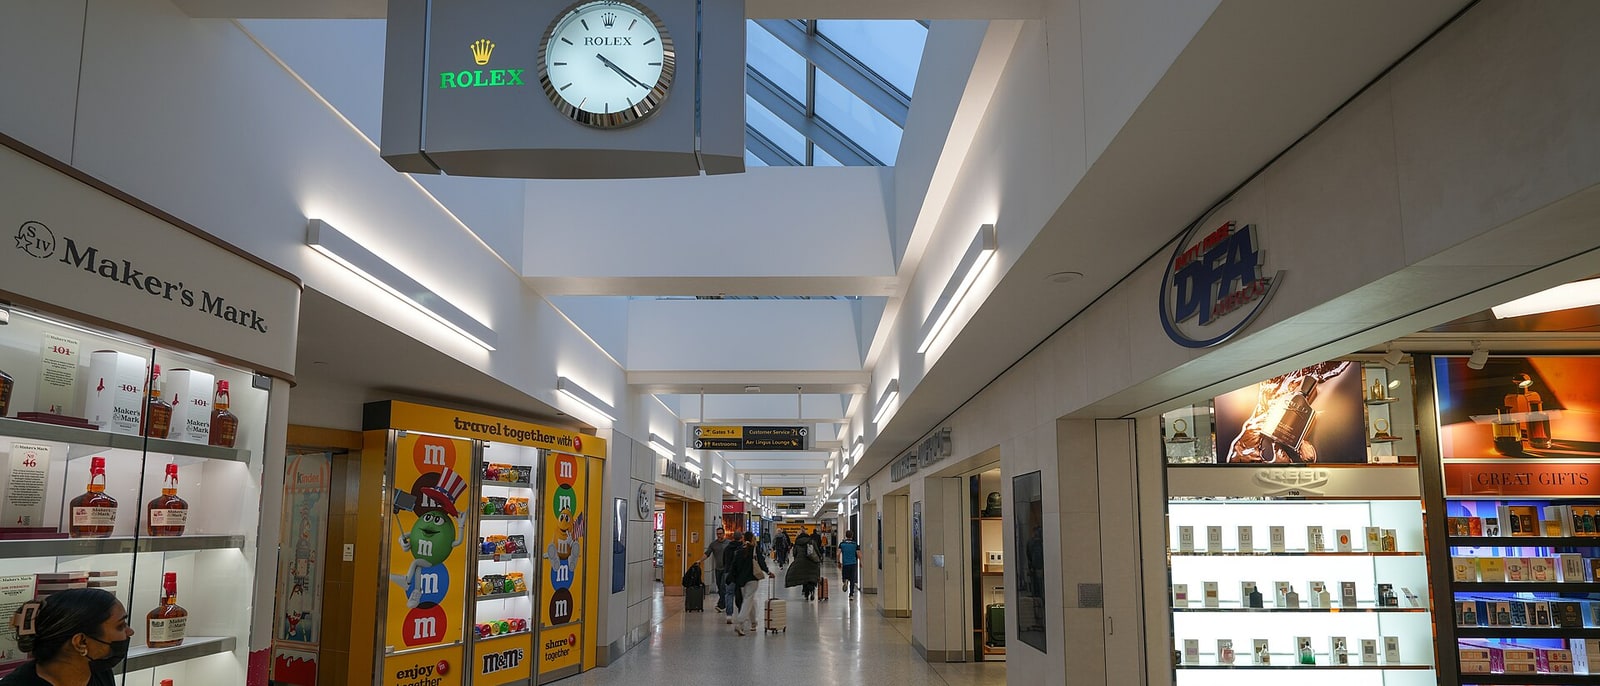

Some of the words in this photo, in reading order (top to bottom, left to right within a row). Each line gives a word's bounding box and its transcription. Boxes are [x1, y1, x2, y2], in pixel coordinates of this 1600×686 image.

[584, 36, 633, 46] ROLEX
[439, 69, 525, 89] ROLEX
[27, 226, 36, 238] S
[1173, 224, 1262, 326] DFA
[59, 237, 194, 307] Maker's
[199, 290, 267, 334] Mark
[52, 345, 71, 356] 101
[121, 384, 138, 393] 101
[194, 398, 207, 407] 101
[113, 406, 141, 417] Maker's
[120, 414, 140, 424] Mark
[186, 418, 210, 428] Maker's
[192, 425, 209, 434] Mark
[453, 416, 502, 436] travel
[503, 425, 556, 445] together
[557, 433, 573, 447] with
[22, 459, 37, 468] 46
[1255, 469, 1329, 482] CREED
[1477, 472, 1534, 486] GREAT
[1538, 472, 1590, 486] GIFTS
[545, 636, 568, 651] share
[545, 647, 570, 662] together
[396, 663, 435, 680] enjoy
[396, 677, 442, 686] ether
